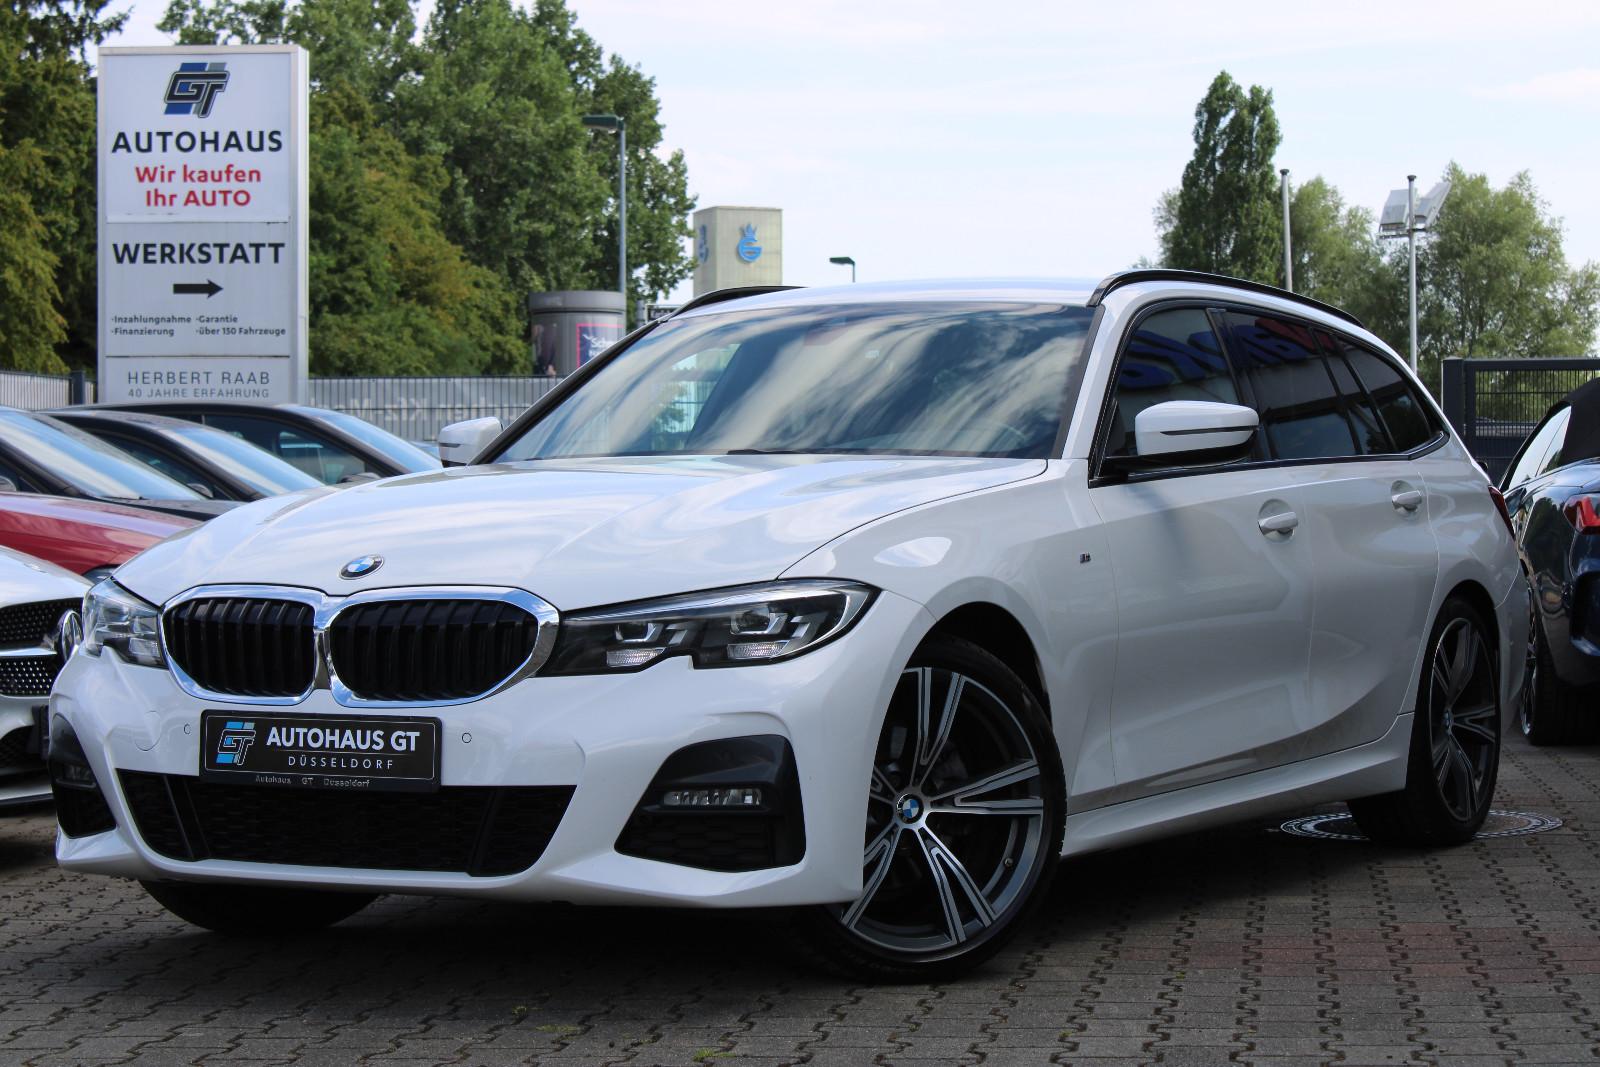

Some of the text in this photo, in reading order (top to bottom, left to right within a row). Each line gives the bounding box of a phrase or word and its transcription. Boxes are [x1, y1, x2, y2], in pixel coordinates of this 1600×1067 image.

[111, 130, 283, 153] AUTOHAUS
[135, 164, 262, 183] Wir kaufen
[146, 188, 252, 207] Ihr AUTO
[112, 242, 286, 265] WERKSTATT
[222, 327, 237, 335] 150
[238, 326, 287, 336] Fahrzeuge
[127, 371, 270, 385] HERBERT RAAB
[128, 388, 270, 398] 40 JAHRE ERFAHRUNG
[266, 726, 421, 752] AUTOHAUS GT
[288, 755, 393, 770] DÜSSELDORF
[301, 777, 314, 785] GT
